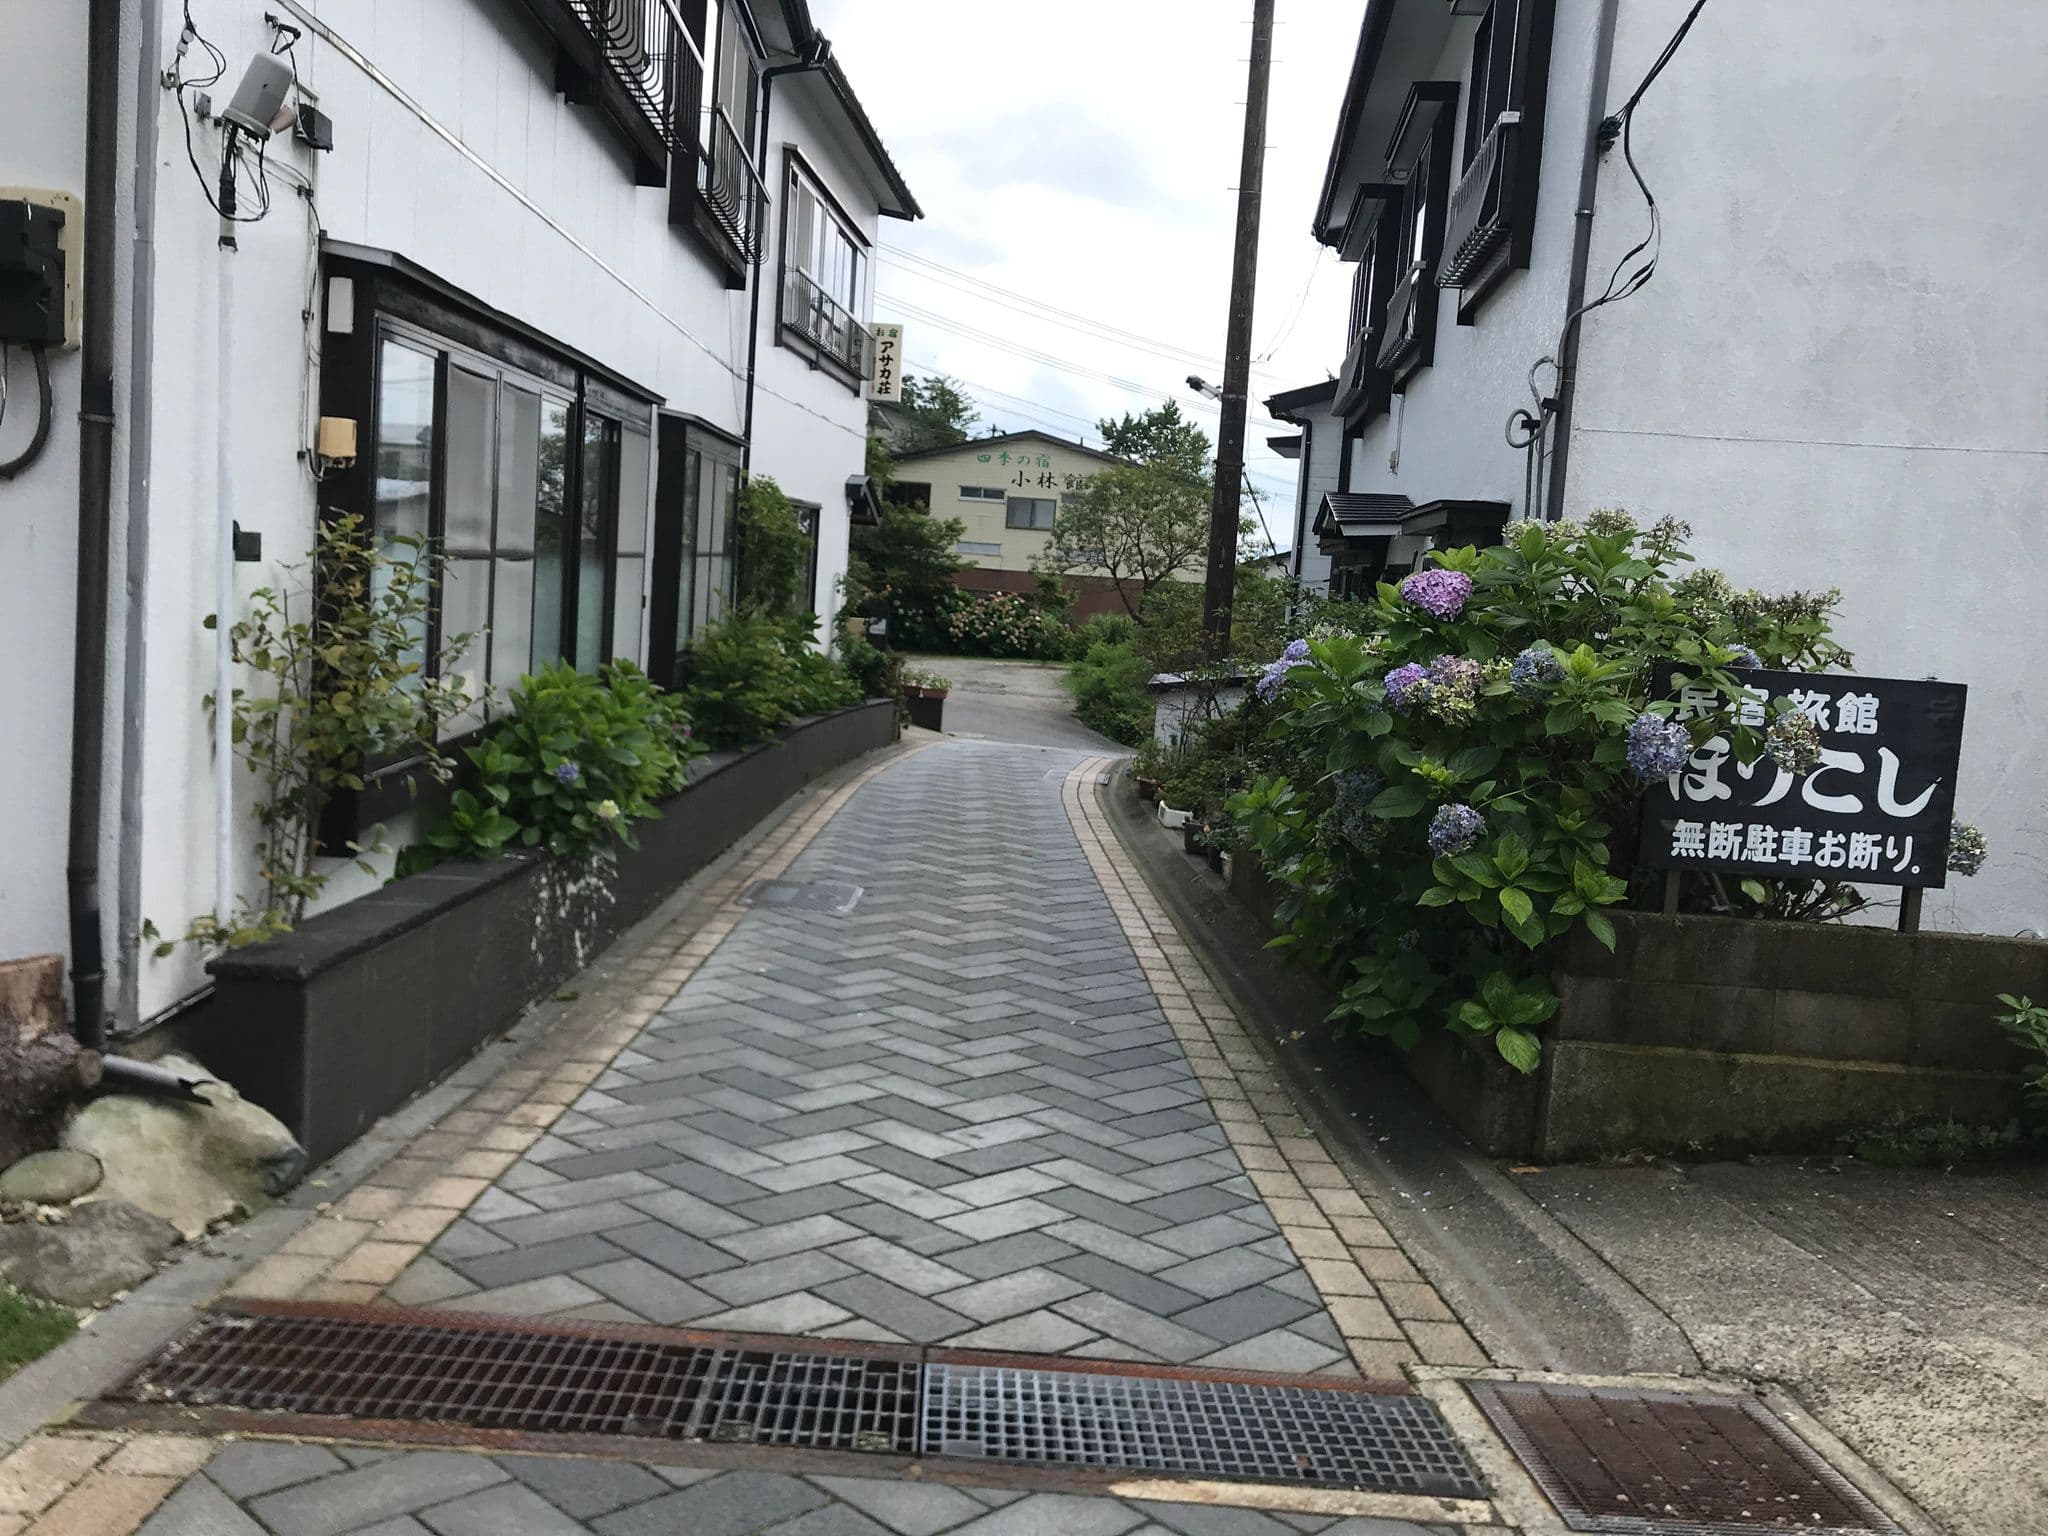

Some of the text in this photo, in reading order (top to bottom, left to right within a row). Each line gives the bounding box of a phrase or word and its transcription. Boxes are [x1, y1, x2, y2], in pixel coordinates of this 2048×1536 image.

[877, 341, 894, 395] アサカ荘
[977, 451, 1051, 469] 四季の宿
[1670, 819, 1922, 875] 無断駐車お断り。
